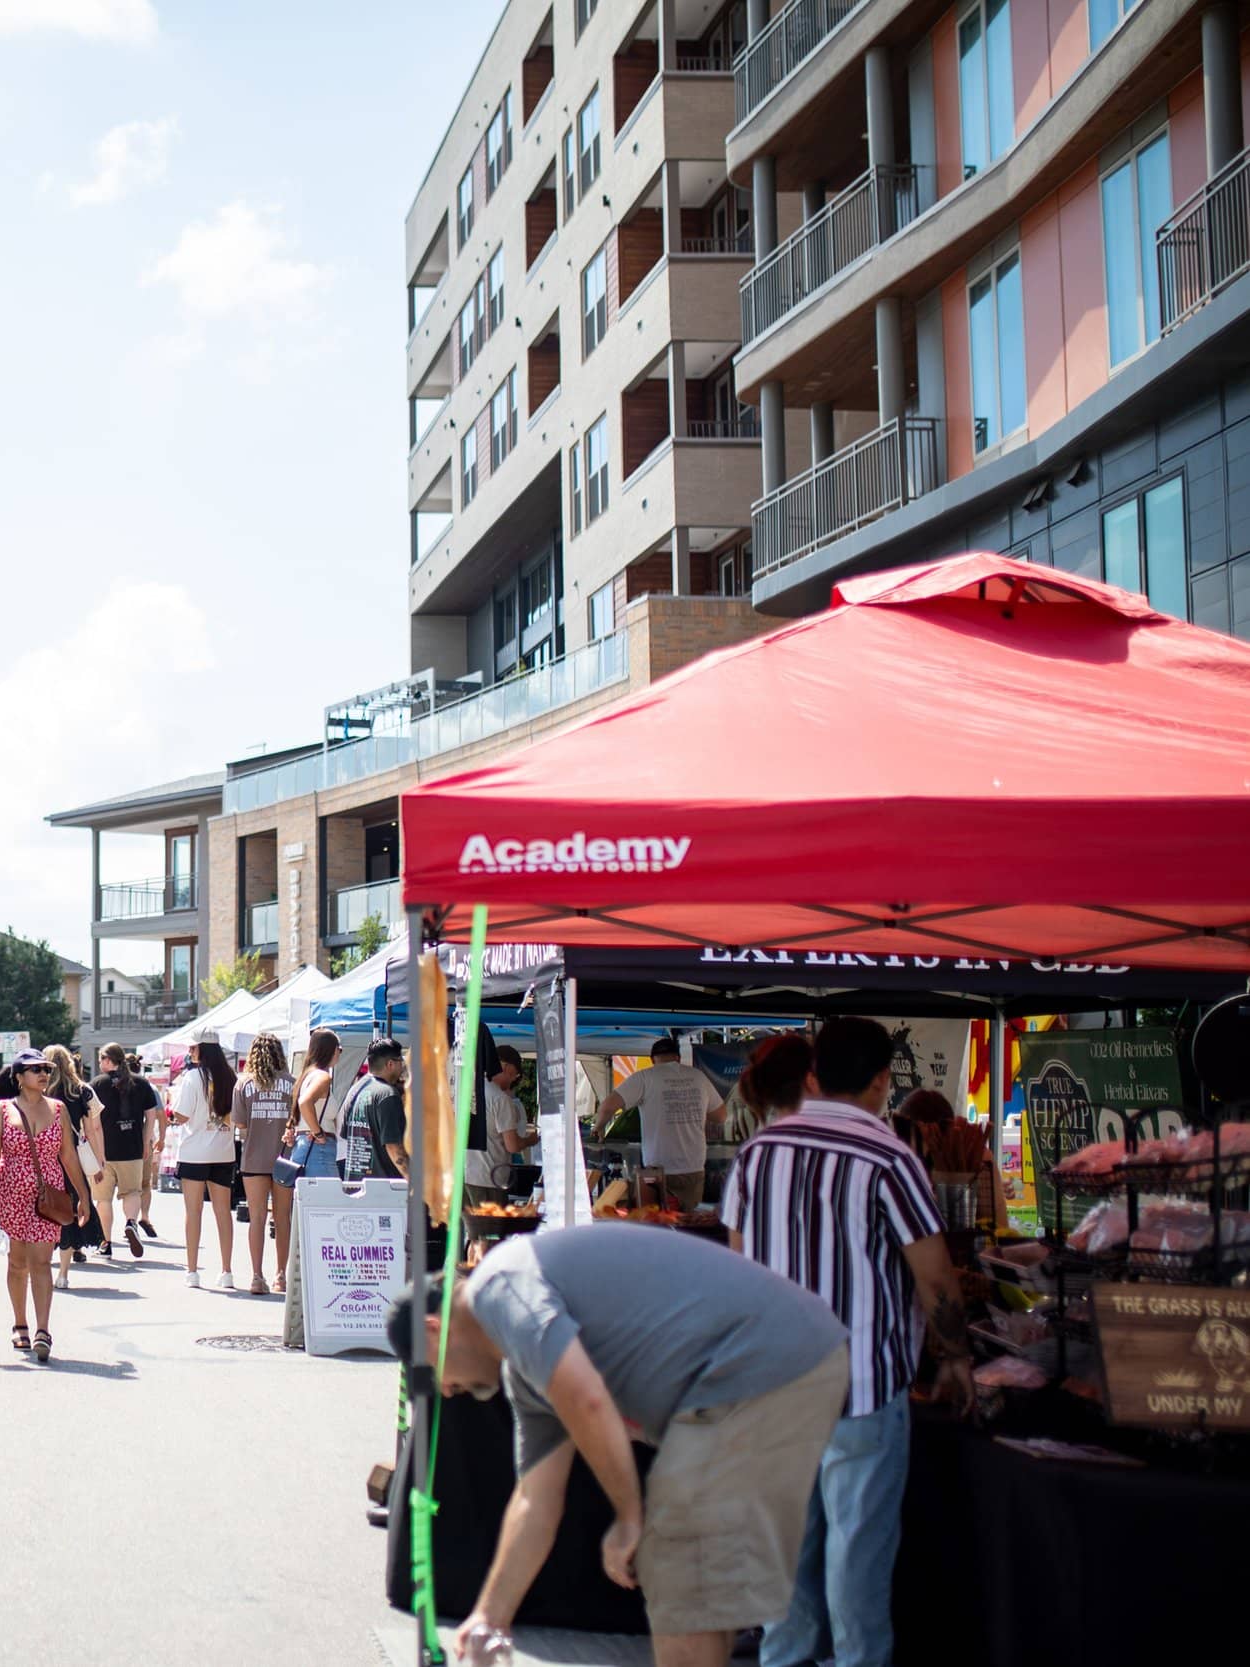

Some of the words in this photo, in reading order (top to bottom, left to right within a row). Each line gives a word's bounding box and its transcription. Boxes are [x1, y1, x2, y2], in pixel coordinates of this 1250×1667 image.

[458, 831, 692, 870] Academy
[1123, 1040, 1174, 1057] Remedies
[1046, 1077, 1074, 1095] TRUE
[1104, 1083, 1134, 1100] Herbal
[1031, 1098, 1090, 1129] HEMP
[1040, 1132, 1088, 1152] SCENCE
[321, 1245, 347, 1261] REAL
[350, 1245, 395, 1261] GUMMIES
[340, 1303, 382, 1313] ORGANIC
[1111, 1295, 1145, 1314] THE
[1149, 1298, 1201, 1317] GRASS
[1205, 1299, 1222, 1317] IS
[1147, 1394, 1211, 1415] UNDER
[1214, 1397, 1243, 1416] MY
